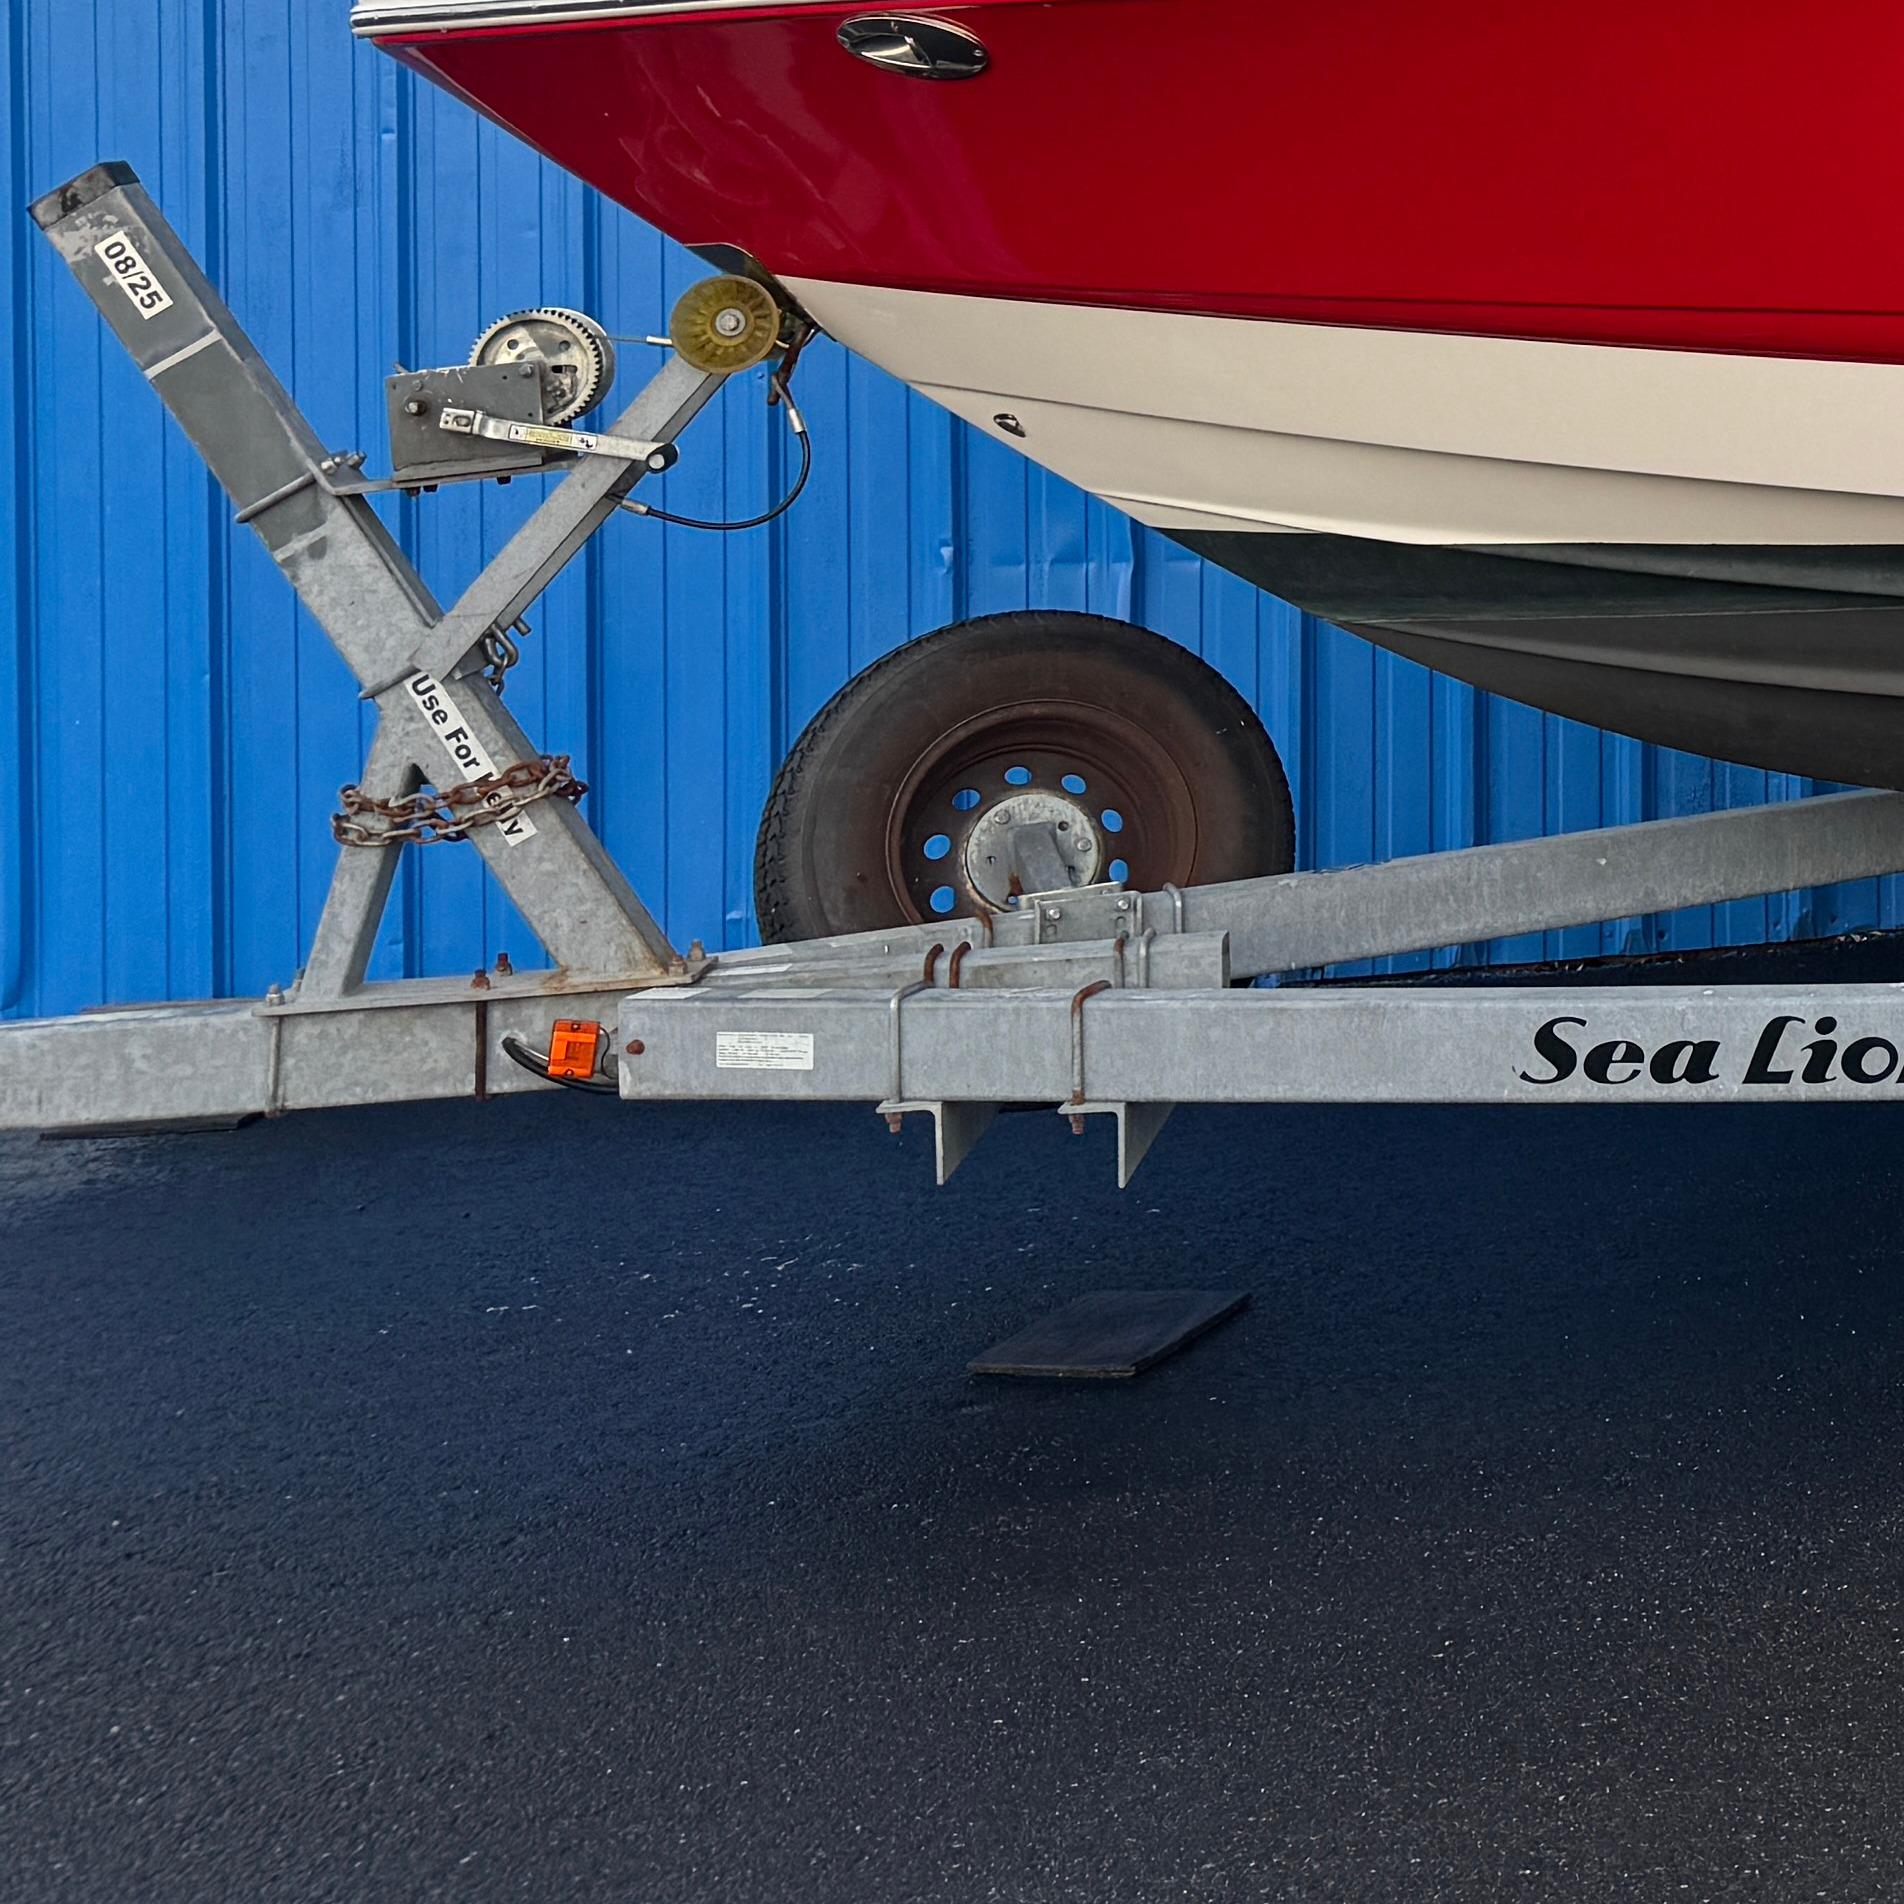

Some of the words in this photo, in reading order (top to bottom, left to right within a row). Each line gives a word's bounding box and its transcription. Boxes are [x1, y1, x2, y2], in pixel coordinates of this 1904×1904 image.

[104, 241, 163, 309] 08/25
[411, 674, 448, 725] Use
[444, 726, 481, 769] For
[1519, 1016, 1720, 1085] Sea
